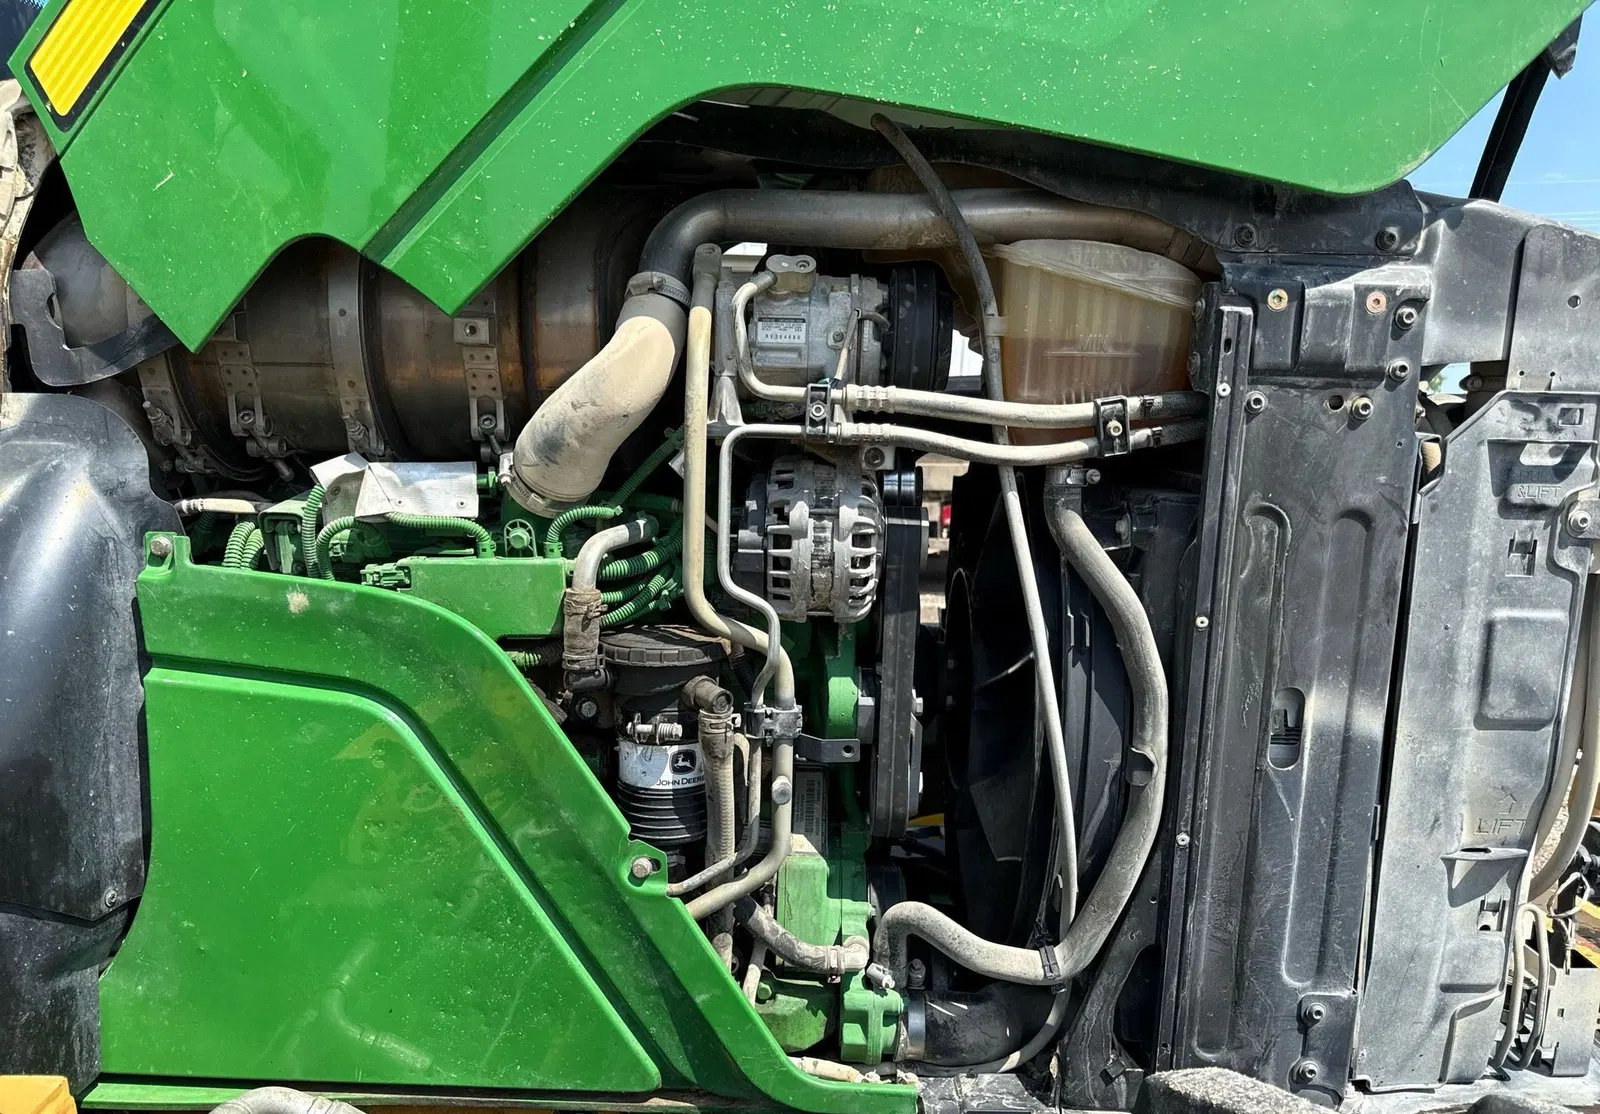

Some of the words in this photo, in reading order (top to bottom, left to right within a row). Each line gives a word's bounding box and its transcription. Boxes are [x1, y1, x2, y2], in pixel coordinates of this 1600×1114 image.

[1517, 485, 1561, 500] &LIFT
[681, 775, 705, 785] DEERE
[1474, 818, 1528, 836] LIFT
